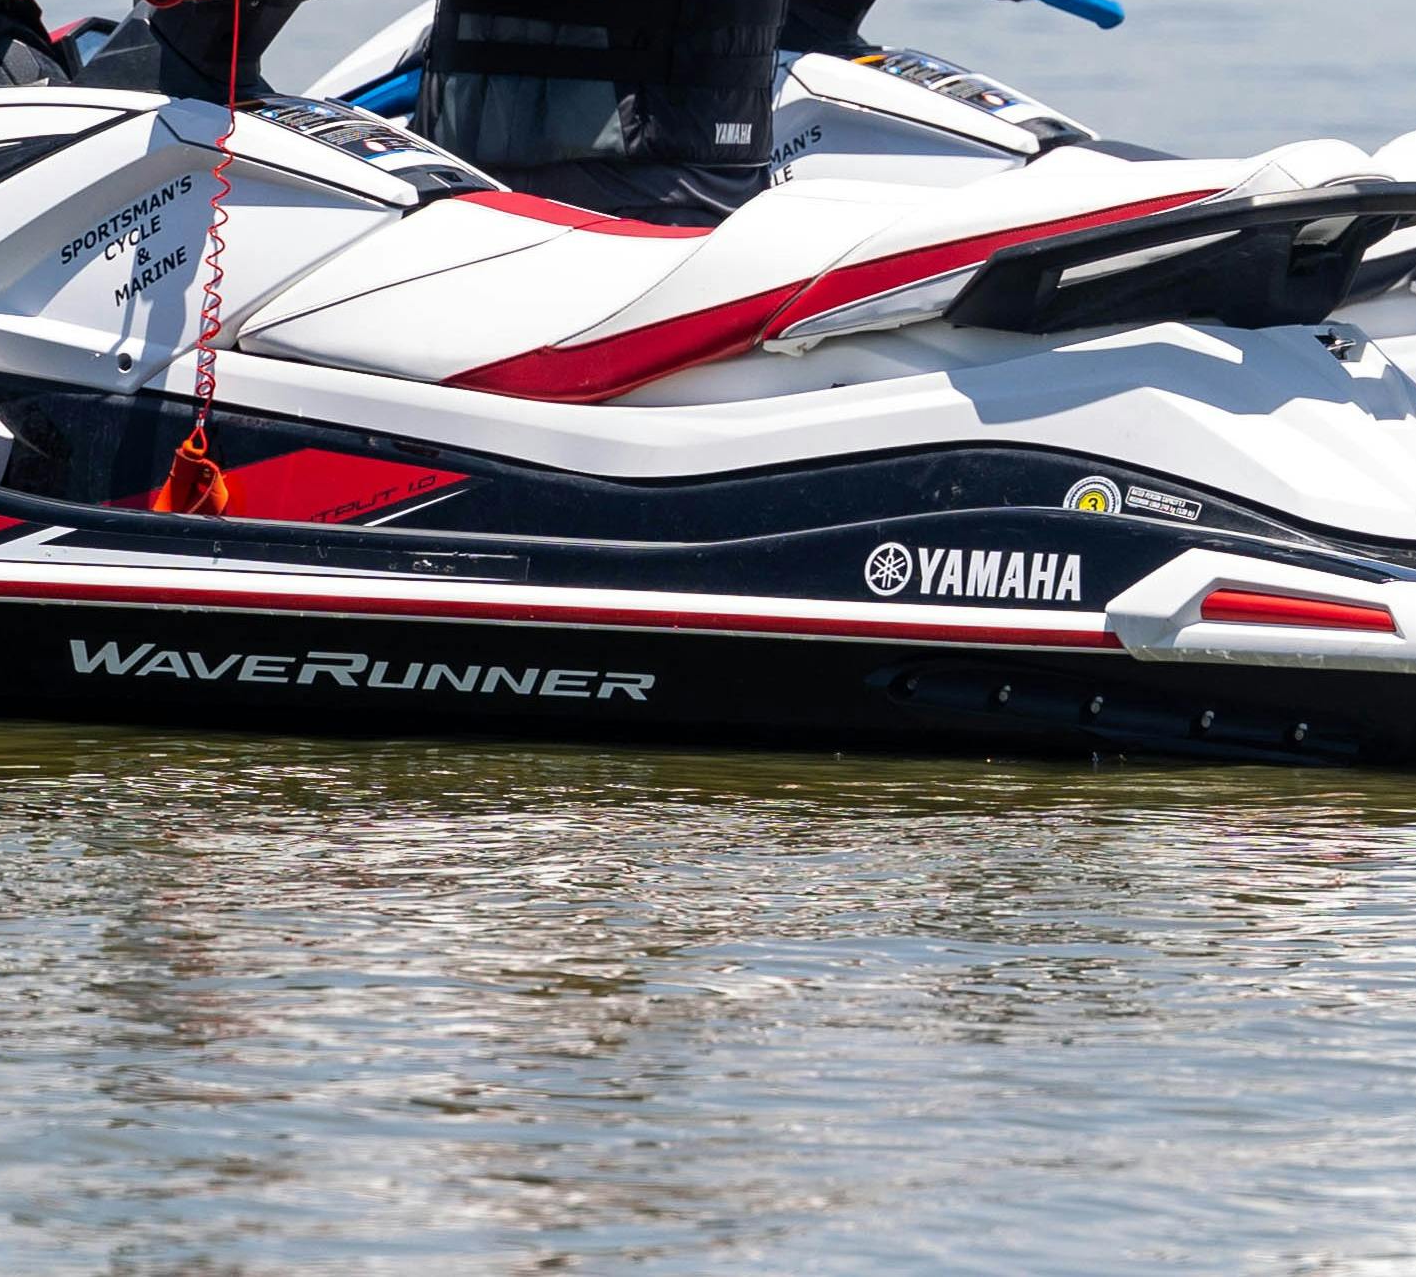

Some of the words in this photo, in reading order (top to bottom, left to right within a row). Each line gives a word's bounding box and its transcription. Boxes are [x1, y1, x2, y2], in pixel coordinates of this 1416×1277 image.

[714, 122, 752, 145] YAMAHA
[769, 125, 823, 169] MAN'S
[60, 174, 193, 265] SPORTSMAN'S
[104, 214, 162, 261] CYCLE
[114, 245, 188, 308] MARINE
[136, 246, 152, 266] &
[917, 547, 1082, 602] YAMAHA
